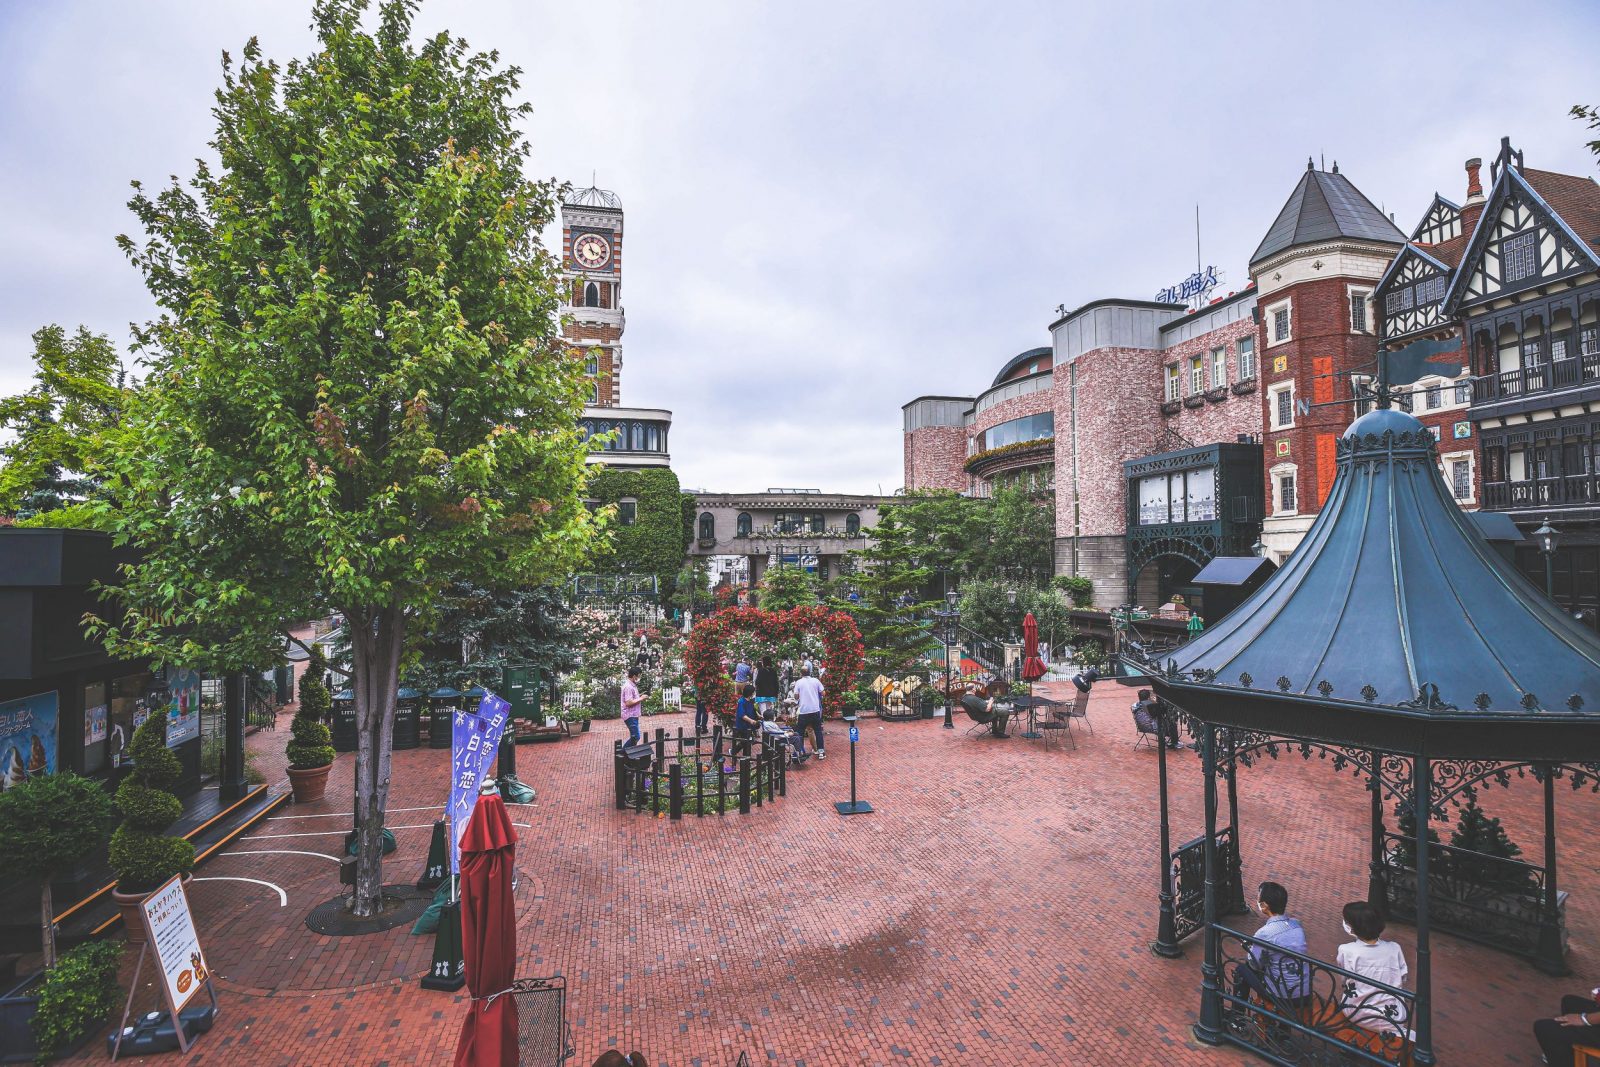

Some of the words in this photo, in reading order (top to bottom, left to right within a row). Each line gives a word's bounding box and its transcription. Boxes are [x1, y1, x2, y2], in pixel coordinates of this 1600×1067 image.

[1155, 265, 1217, 304] 白い恋人
[456, 733, 481, 810] 白い恋人
